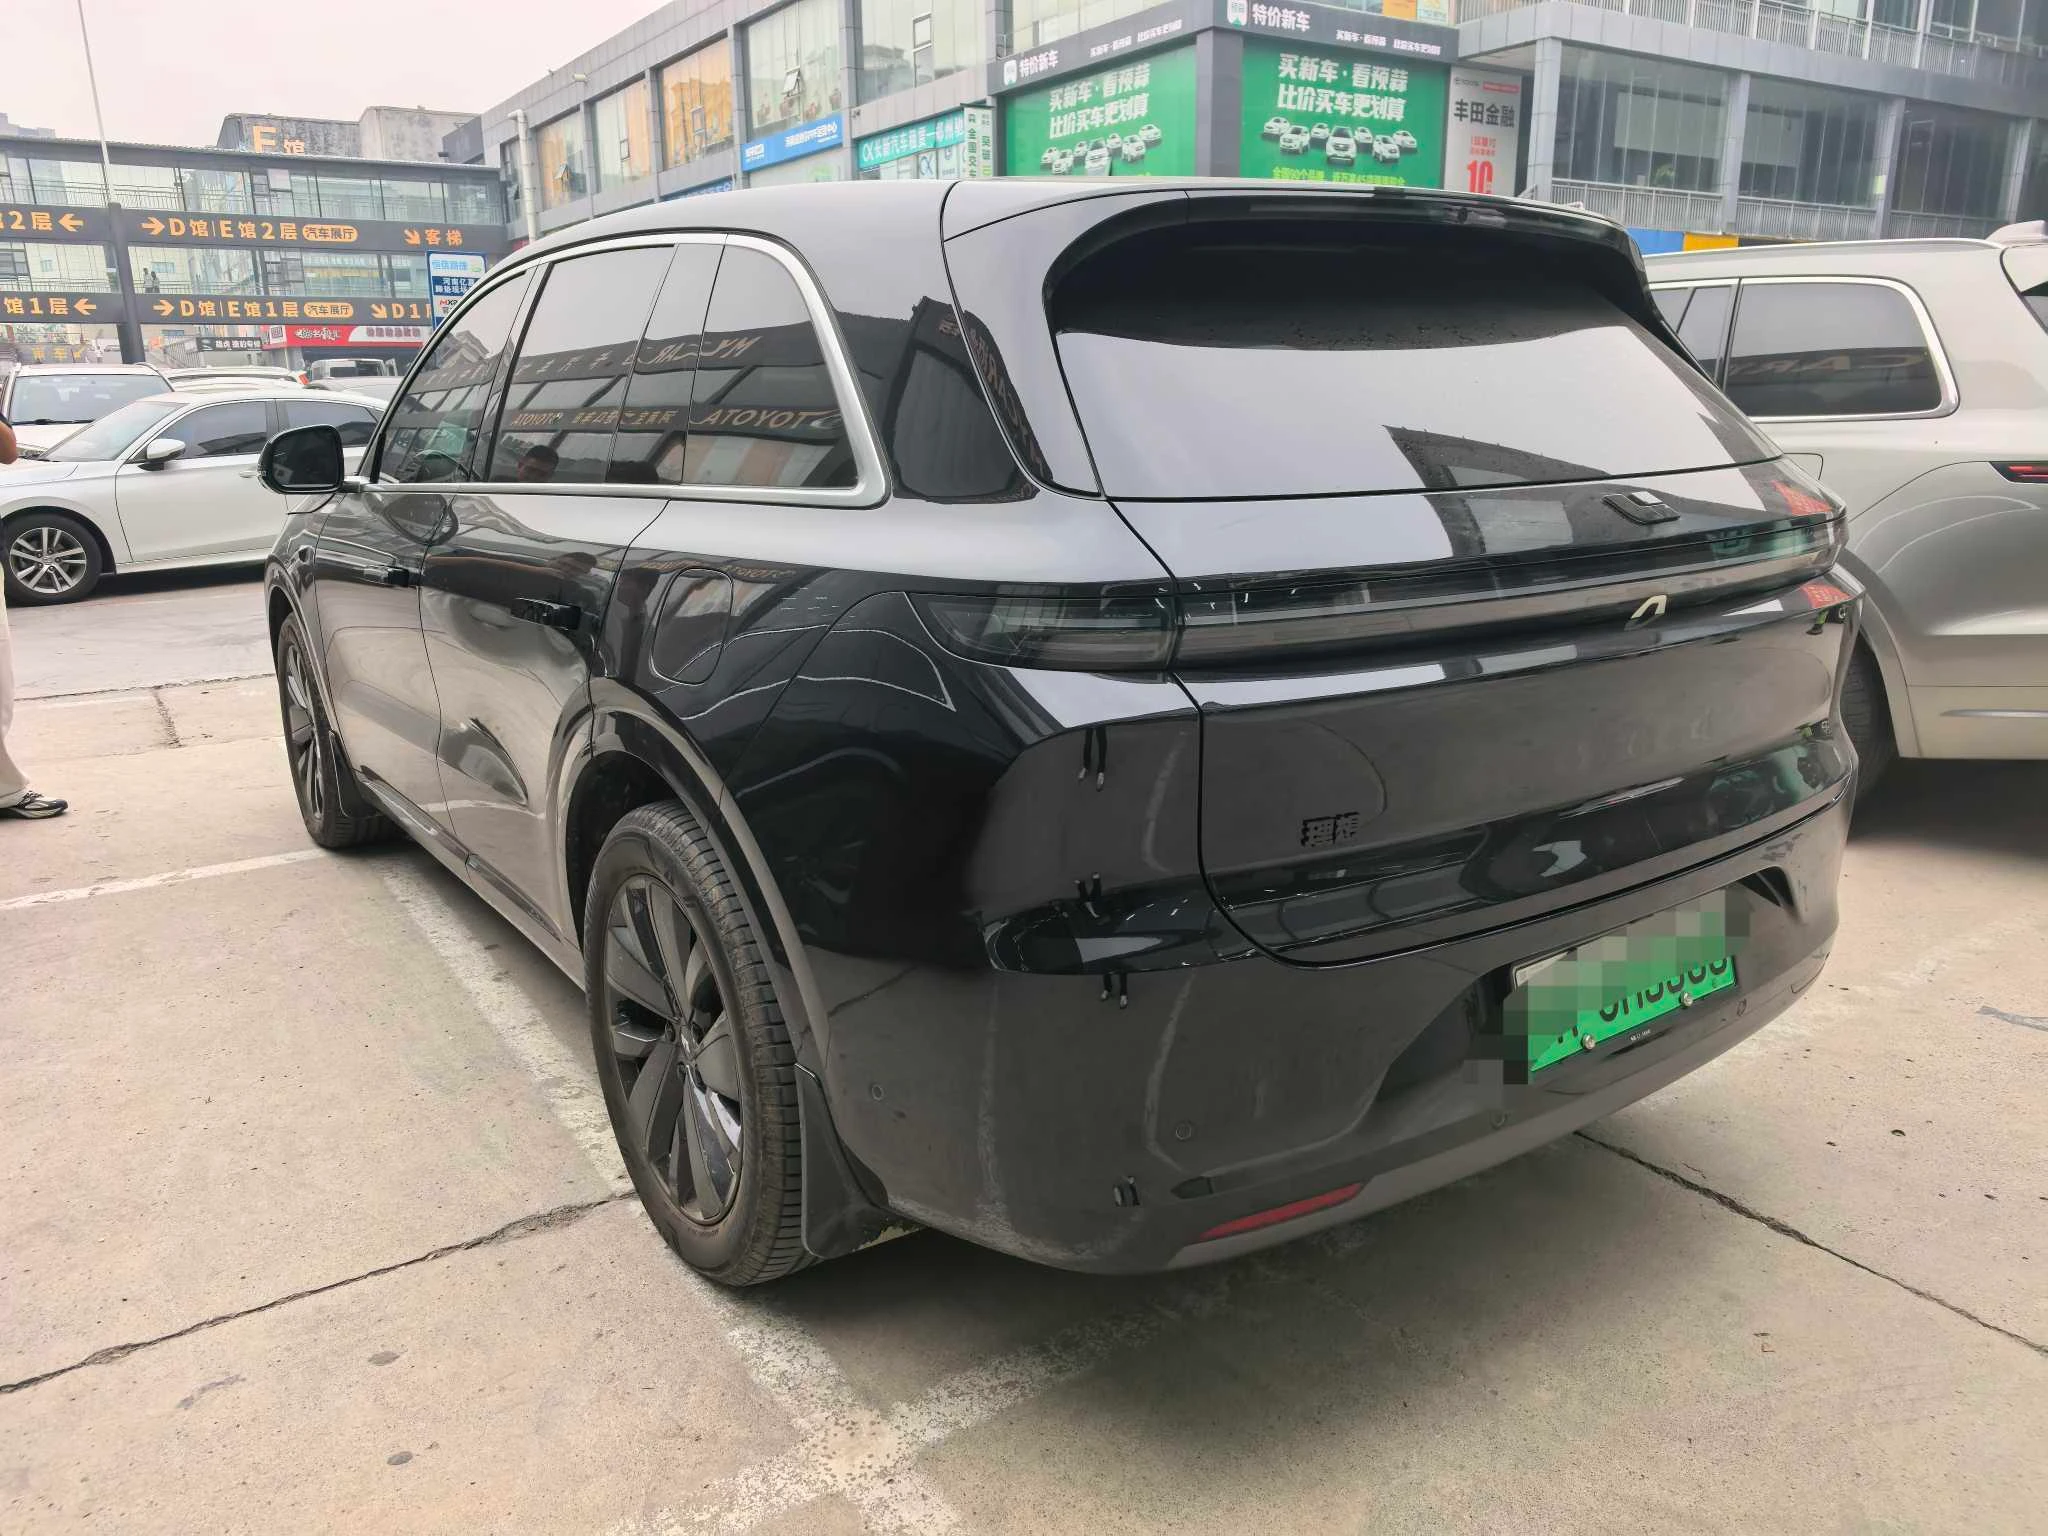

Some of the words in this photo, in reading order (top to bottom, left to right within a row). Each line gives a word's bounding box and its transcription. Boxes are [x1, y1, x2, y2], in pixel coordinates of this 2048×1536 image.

[1252, 3, 1310, 33] 特价新车
[1019, 49, 1058, 78] 特价新车
[1049, 92, 1150, 139] 比价买车更划算
[1277, 83, 1408, 122] 比价买车更划算
[1454, 98, 1515, 128] 丰田金融
[0, 210, 53, 231] 2层
[305, 226, 354, 239] 汽车展厅
[425, 228, 463, 246] 客梯
[307, 303, 350, 316] 汽车展厅
[1300, 811, 1360, 848] 理想
